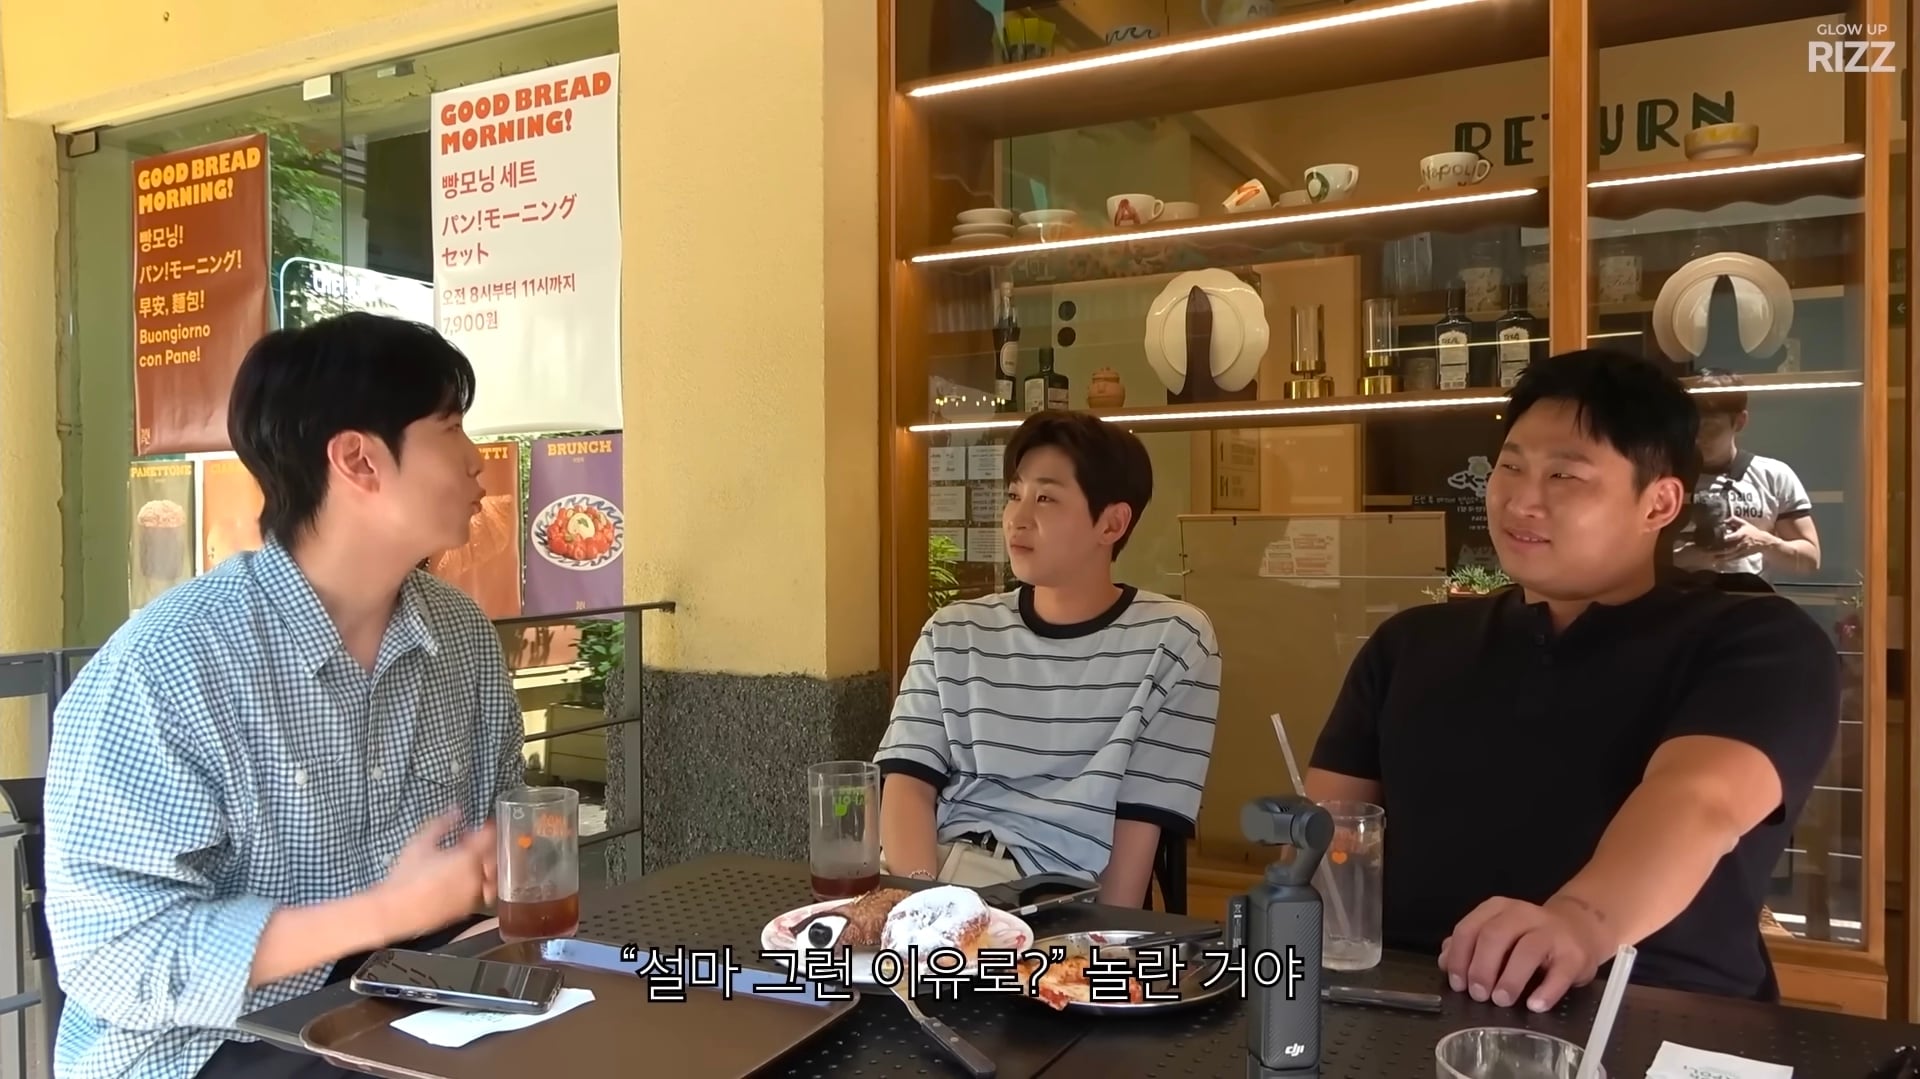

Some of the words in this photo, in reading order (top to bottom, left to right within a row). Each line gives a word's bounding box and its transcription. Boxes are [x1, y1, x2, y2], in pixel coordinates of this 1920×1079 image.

[441, 92, 510, 126] GOOD
[515, 71, 612, 112] BREAD
[441, 108, 573, 156] MORNING!
[1454, 90, 1735, 167] REURN
[138, 162, 189, 190] GOOD
[191, 147, 261, 180] BREAD
[442, 165, 495, 199] 빵모닝
[500, 160, 537, 188] 세트
[138, 177, 234, 215] MORNING!
[139, 223, 184, 253] 빵모닝!
[442, 242, 489, 268] セット
[442, 287, 466, 306] 오전
[470, 280, 517, 304] 8시부터
[521, 272, 576, 297] 11시까지
[139, 323, 211, 345] Buongiorno
[442, 310, 498, 336] 7,900원
[139, 353, 162, 368] con
[165, 346, 201, 366] Pane!
[547, 440, 612, 456] BRUNCH
